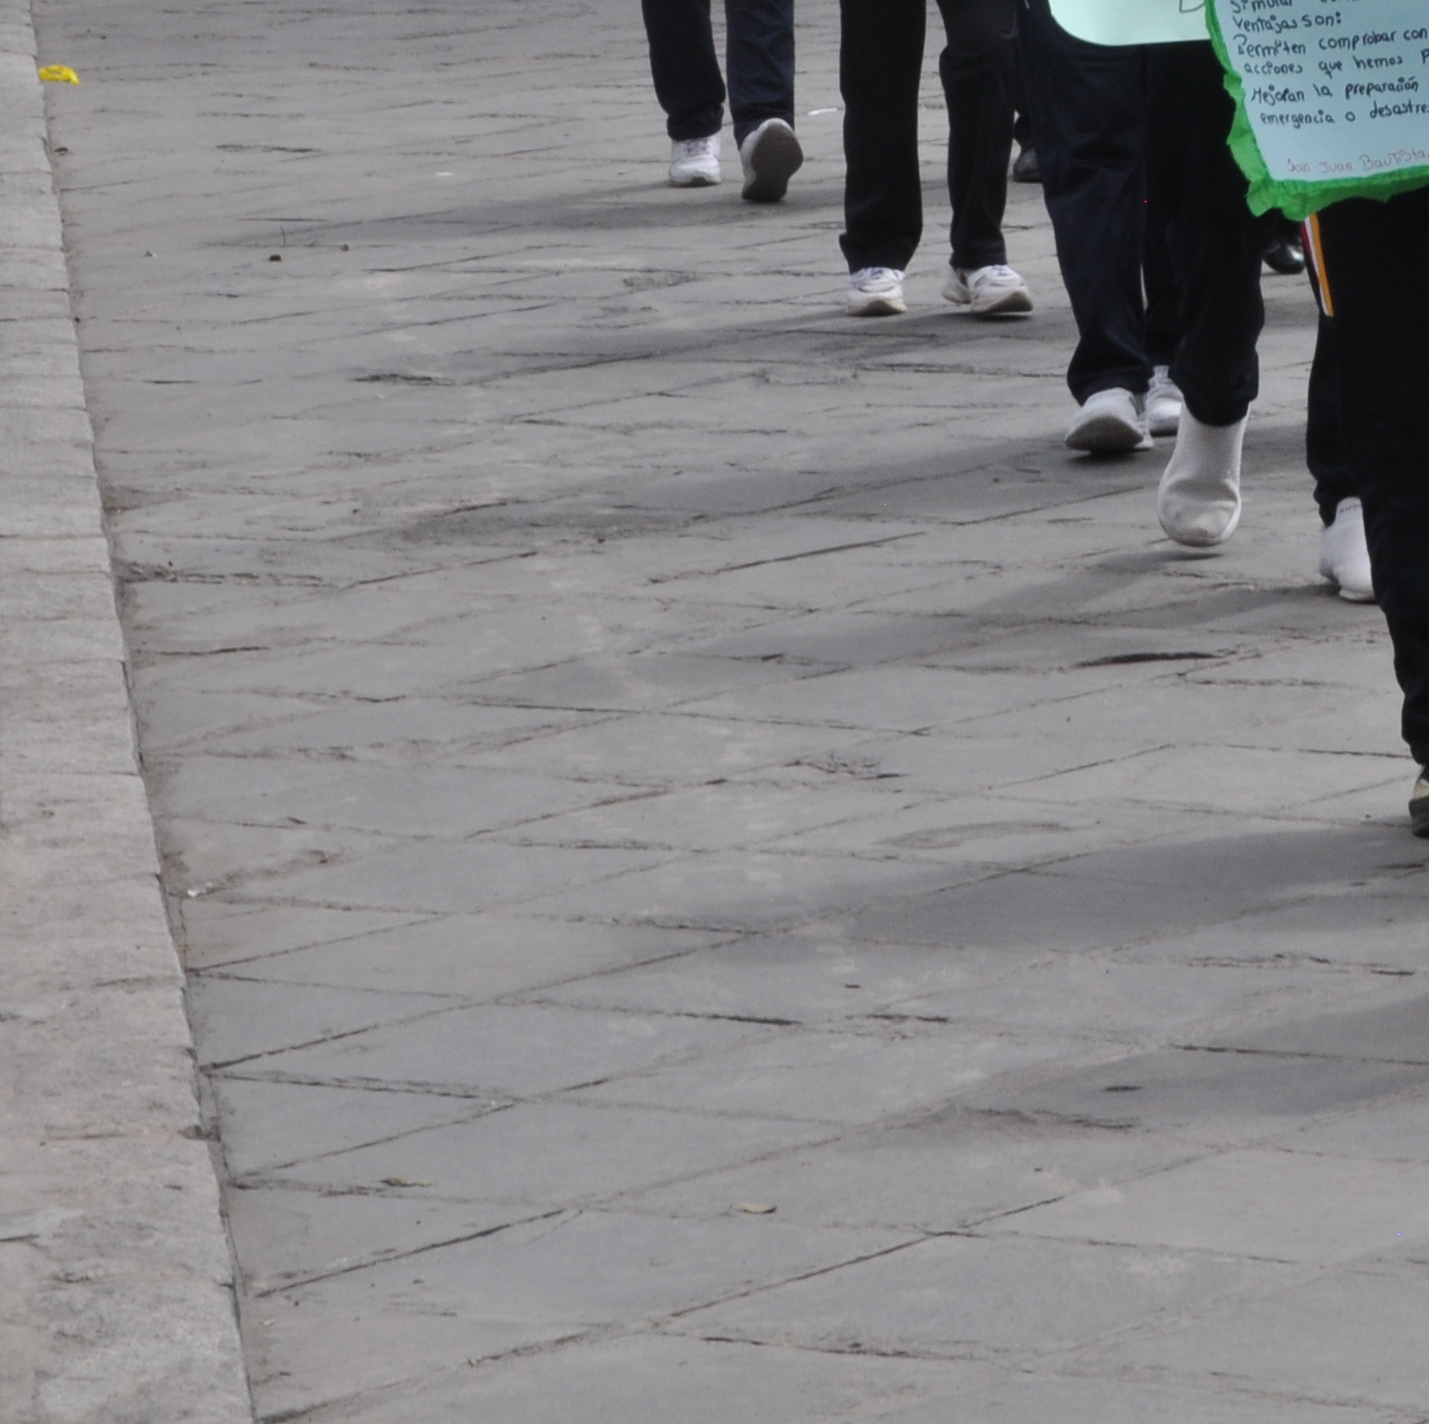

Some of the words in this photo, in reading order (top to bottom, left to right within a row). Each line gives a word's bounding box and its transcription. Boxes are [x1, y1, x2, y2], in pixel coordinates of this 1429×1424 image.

[1318, 30, 1397, 51] comprobar
[1403, 27, 1428, 41] con
[1244, 61, 1303, 75] acciones
[1318, 60, 1343, 79] que
[1352, 54, 1404, 70] hemos
[1312, 83, 1333, 98] la
[1260, 109, 1335, 129] emergencia
[1344, 111, 1356, 122] o
